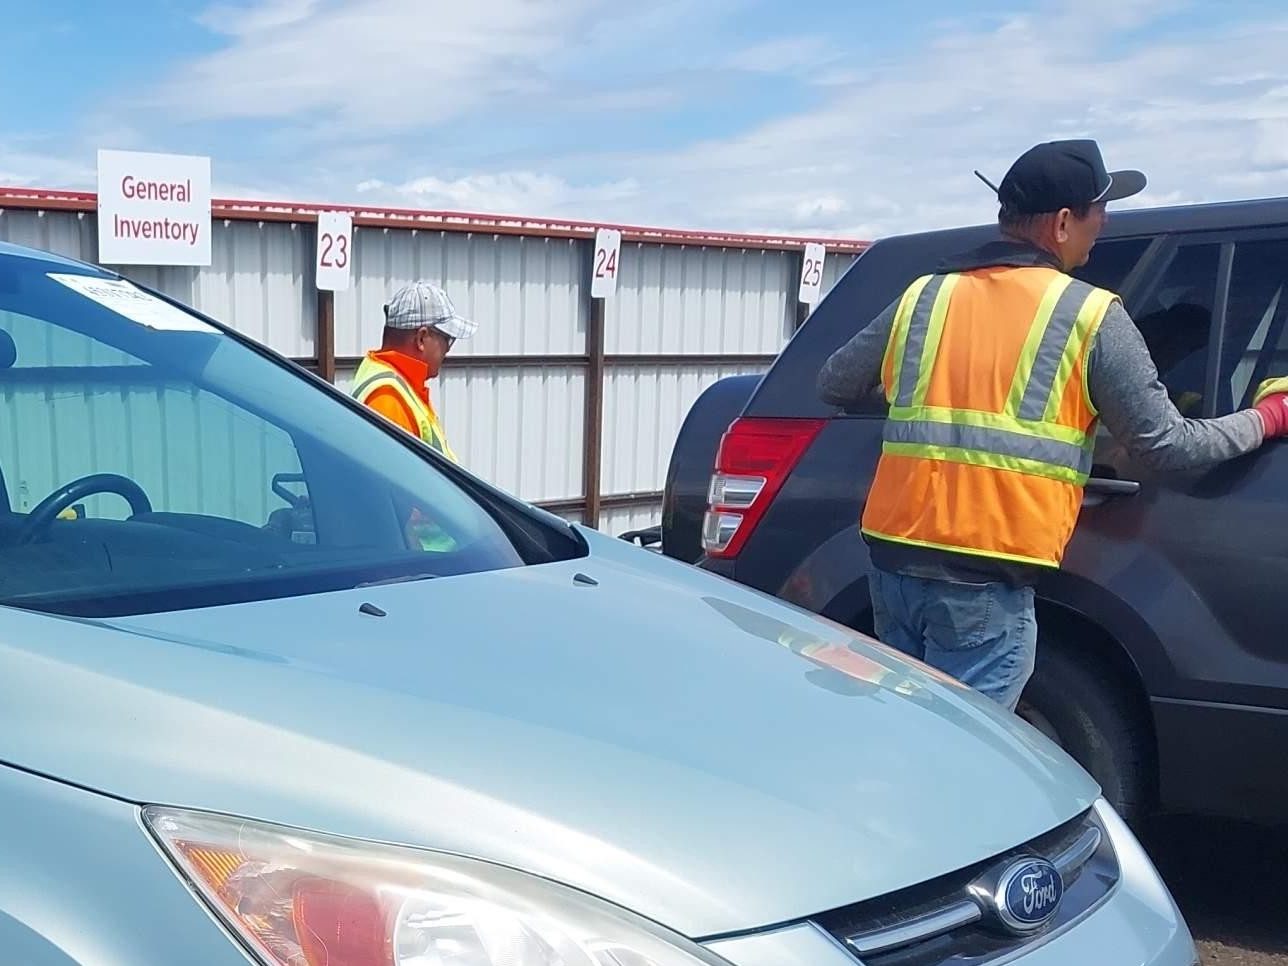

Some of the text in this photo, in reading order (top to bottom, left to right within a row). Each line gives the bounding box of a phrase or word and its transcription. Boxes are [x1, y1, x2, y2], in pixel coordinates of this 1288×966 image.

[122, 175, 191, 203] General
[114, 213, 199, 246] Inventory
[320, 233, 347, 268] 23
[595, 248, 616, 279] 24
[803, 258, 821, 286] 25
[1021, 870, 1056, 914] Ford
